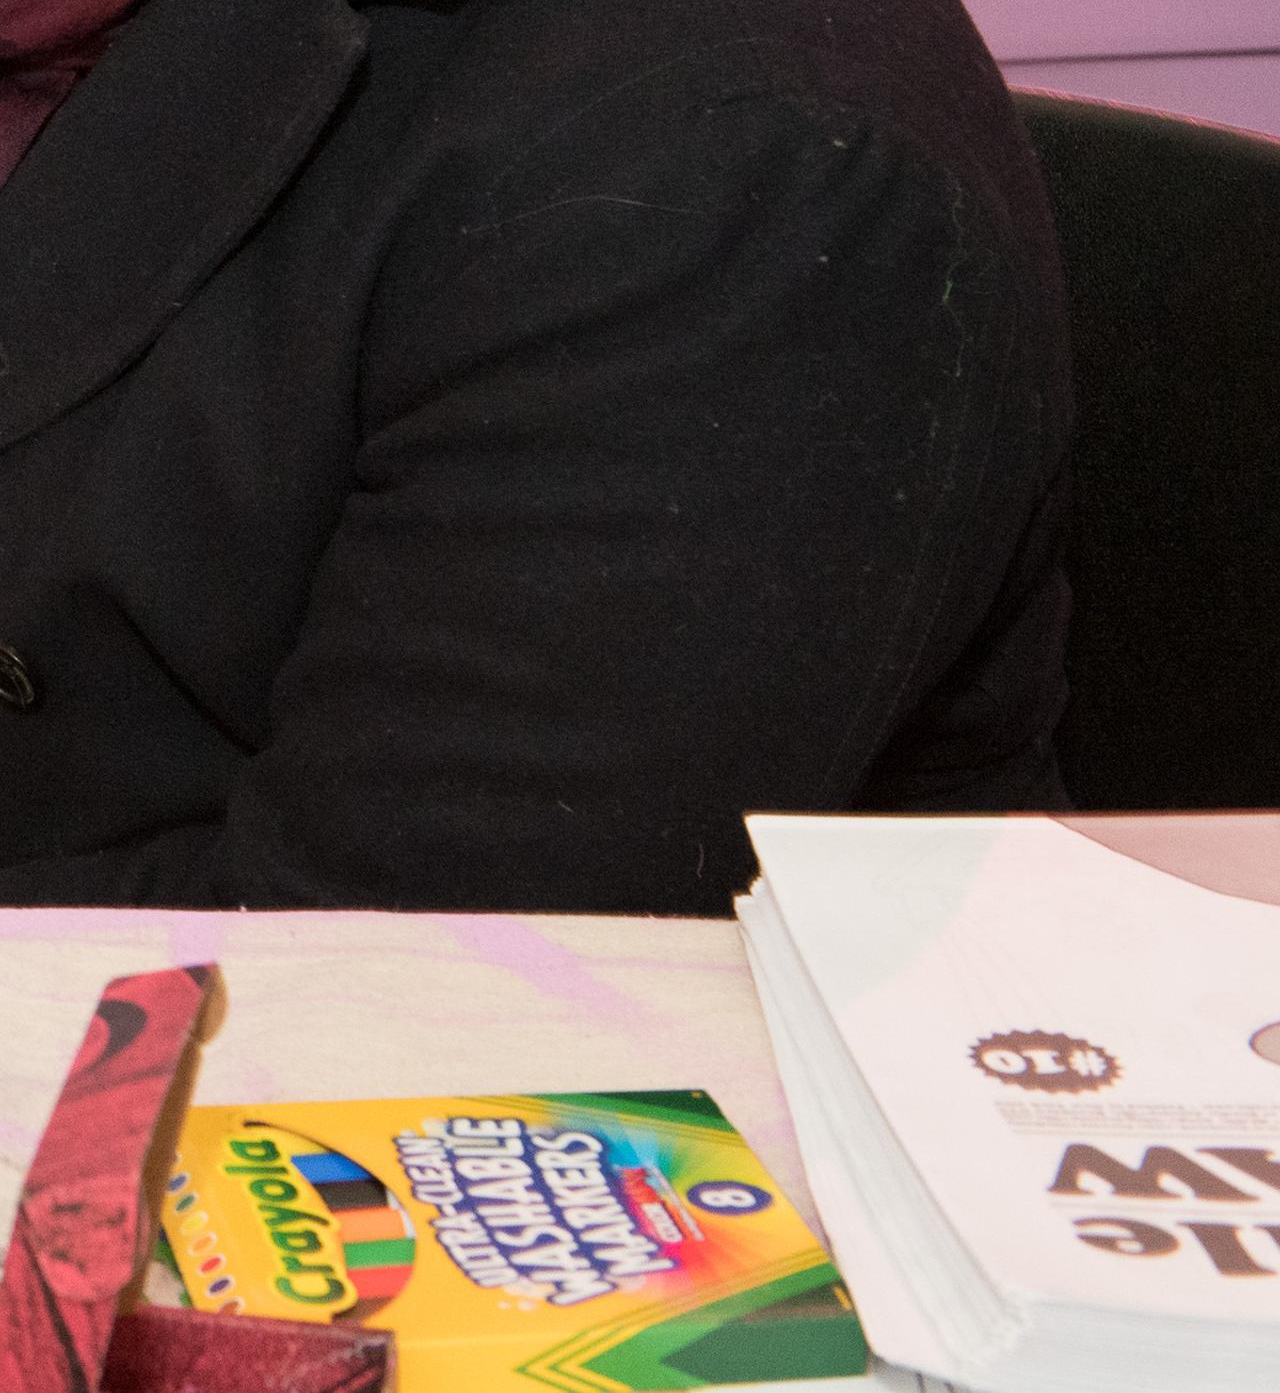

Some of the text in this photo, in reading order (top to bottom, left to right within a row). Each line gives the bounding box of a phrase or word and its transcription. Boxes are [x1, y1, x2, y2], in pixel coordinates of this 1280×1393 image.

[225, 1138, 339, 1303] Crayola
[394, 1136, 519, 1287] ULTRA-CLEAN
[448, 1117, 618, 1305] WASHABLE
[531, 1132, 676, 1274] MARKERS
[699, 1189, 756, 1208] 8
